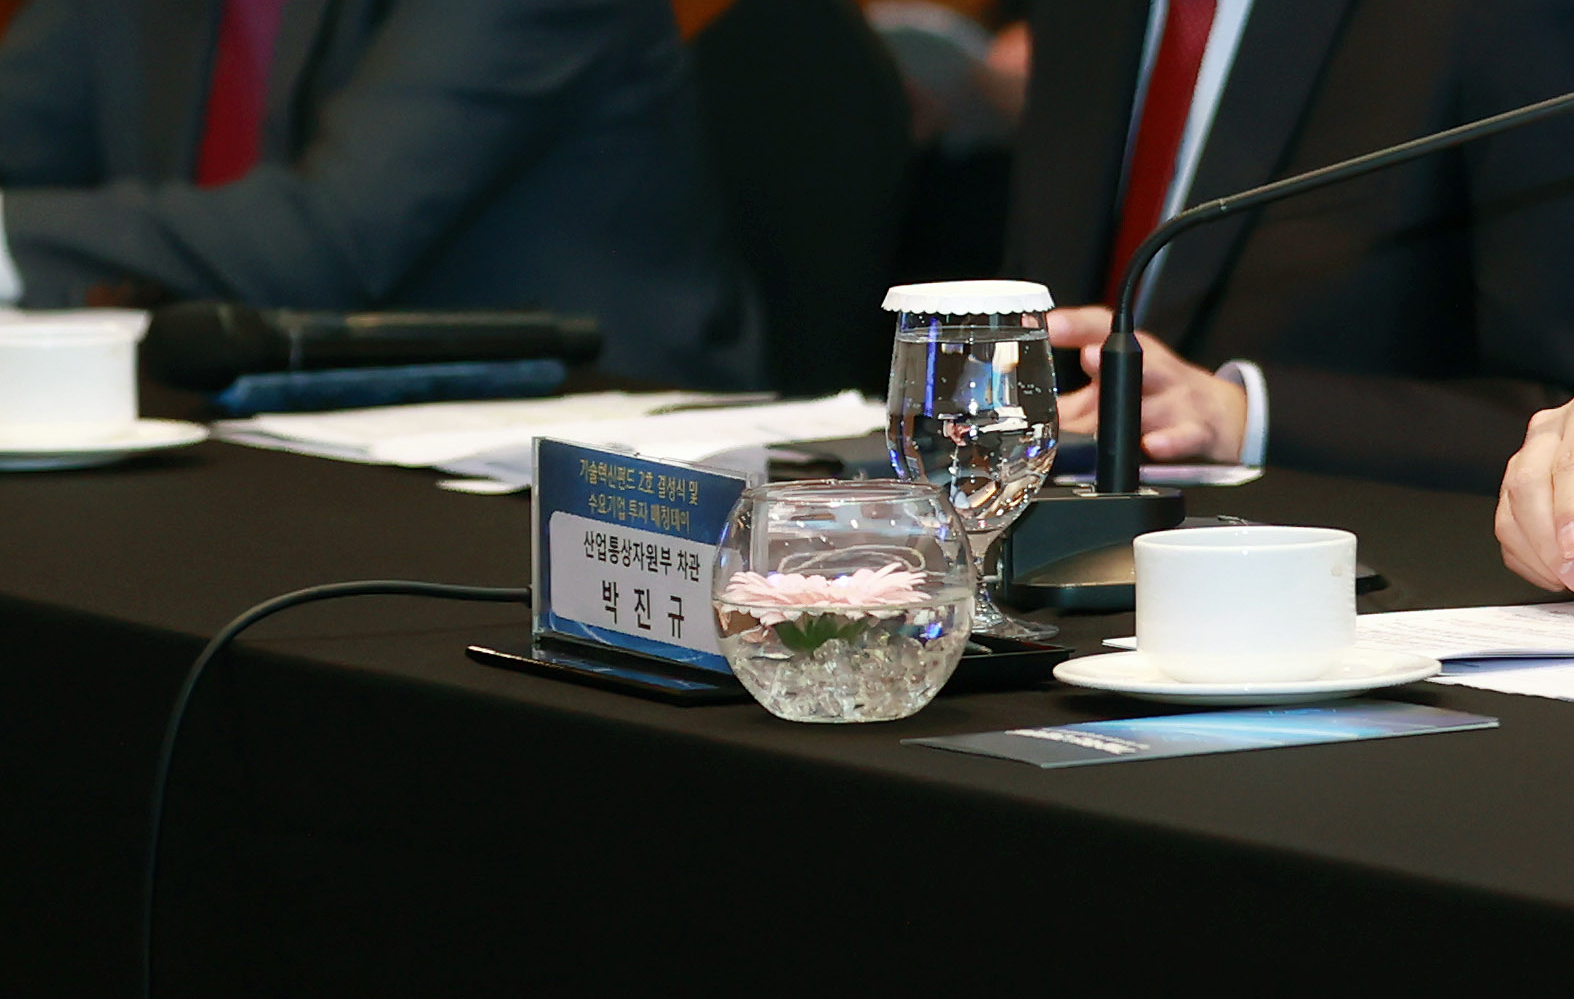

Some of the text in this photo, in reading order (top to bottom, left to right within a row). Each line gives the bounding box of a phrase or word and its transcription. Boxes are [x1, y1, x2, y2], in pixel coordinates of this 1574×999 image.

[579, 459, 698, 505] 기술혁신펀드 2호 결성식 및
[588, 494, 626, 521] 수요기업
[628, 500, 648, 524] 투자
[584, 531, 700, 582] 산업통상자원부 차관
